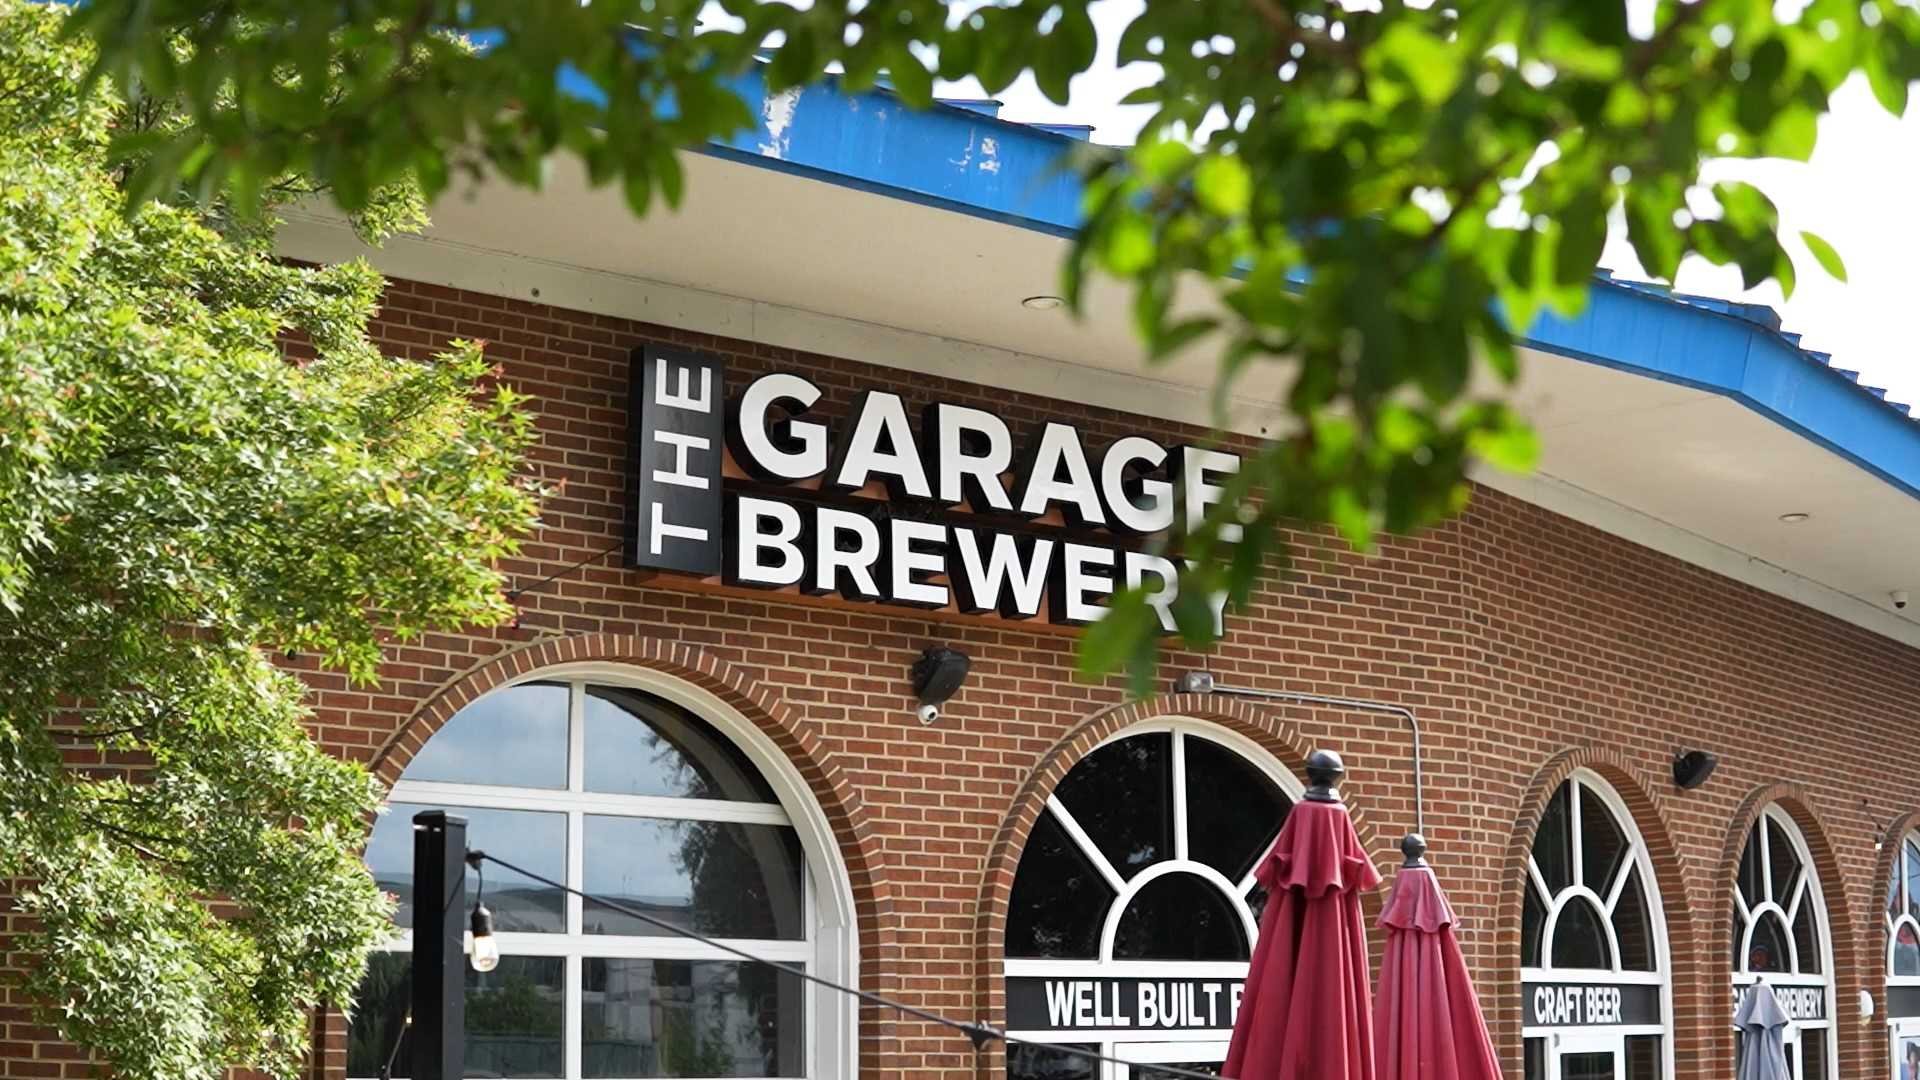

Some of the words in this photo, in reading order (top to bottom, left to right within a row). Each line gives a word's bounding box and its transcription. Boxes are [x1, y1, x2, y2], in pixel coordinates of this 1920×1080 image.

[650, 358, 712, 555] THE
[739, 373, 1244, 544] GARAGE
[1045, 980, 1130, 1027] WELL
[1138, 981, 1222, 1028] BUILT
[1534, 986, 1583, 1024] CRAFT
[1585, 986, 1622, 1024] BEER
